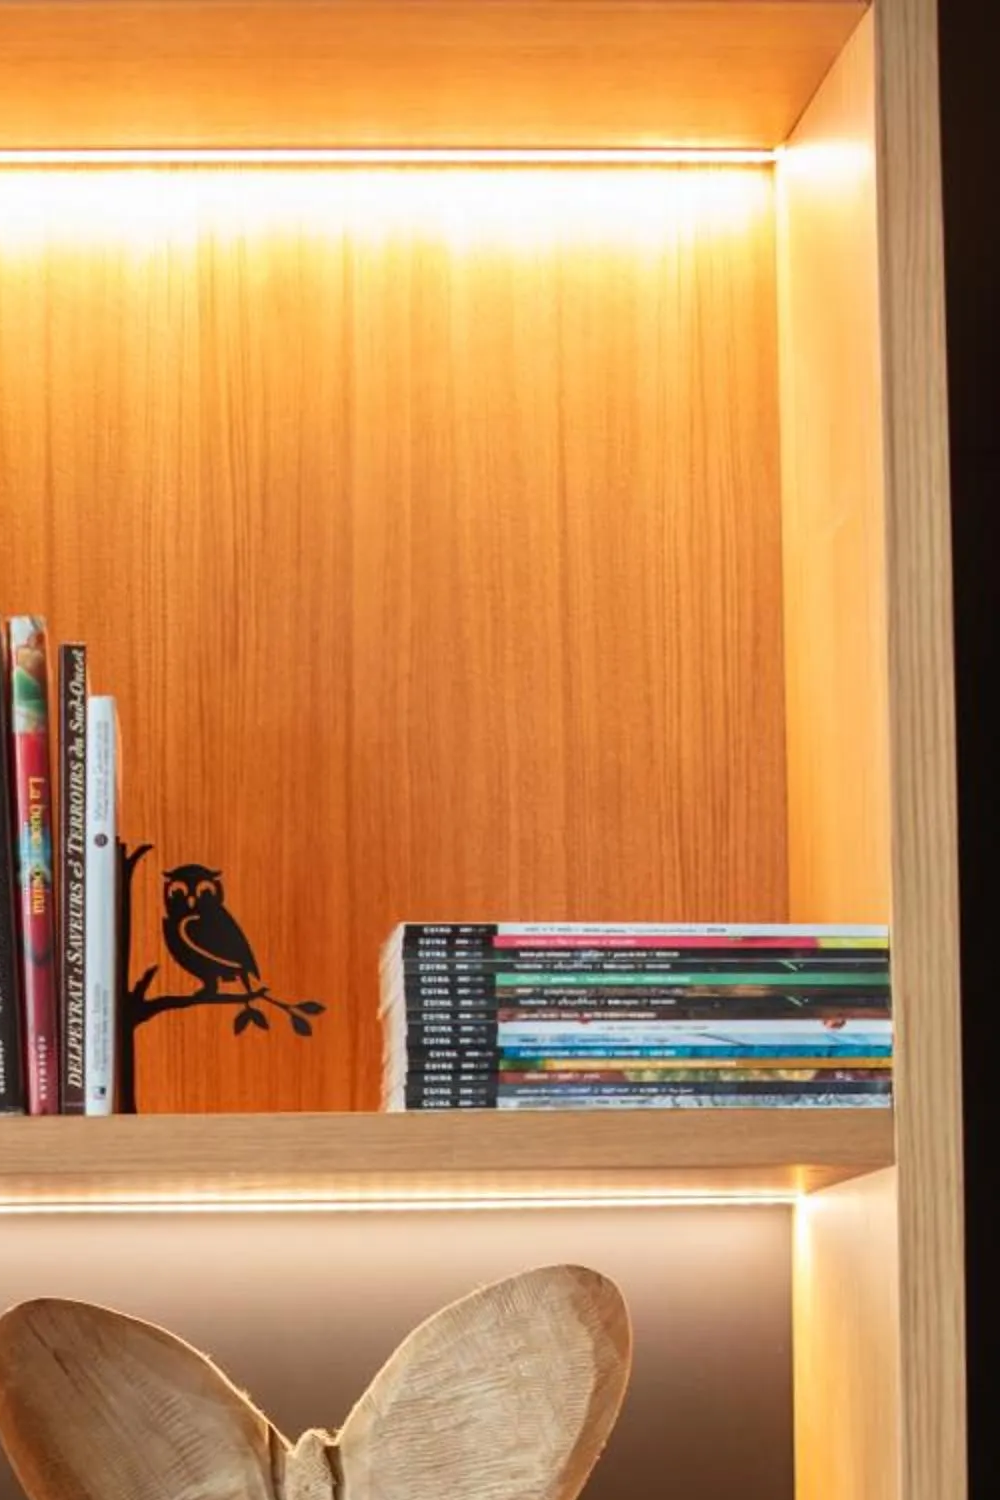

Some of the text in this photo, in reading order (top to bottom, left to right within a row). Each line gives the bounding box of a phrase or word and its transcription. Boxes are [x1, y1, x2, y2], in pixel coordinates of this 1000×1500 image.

[28, 776, 46, 800] La
[67, 760, 85, 856] TERROIRS
[66, 882, 84, 966] SAVEURS
[67, 975, 85, 1089] DELPEYRAT
